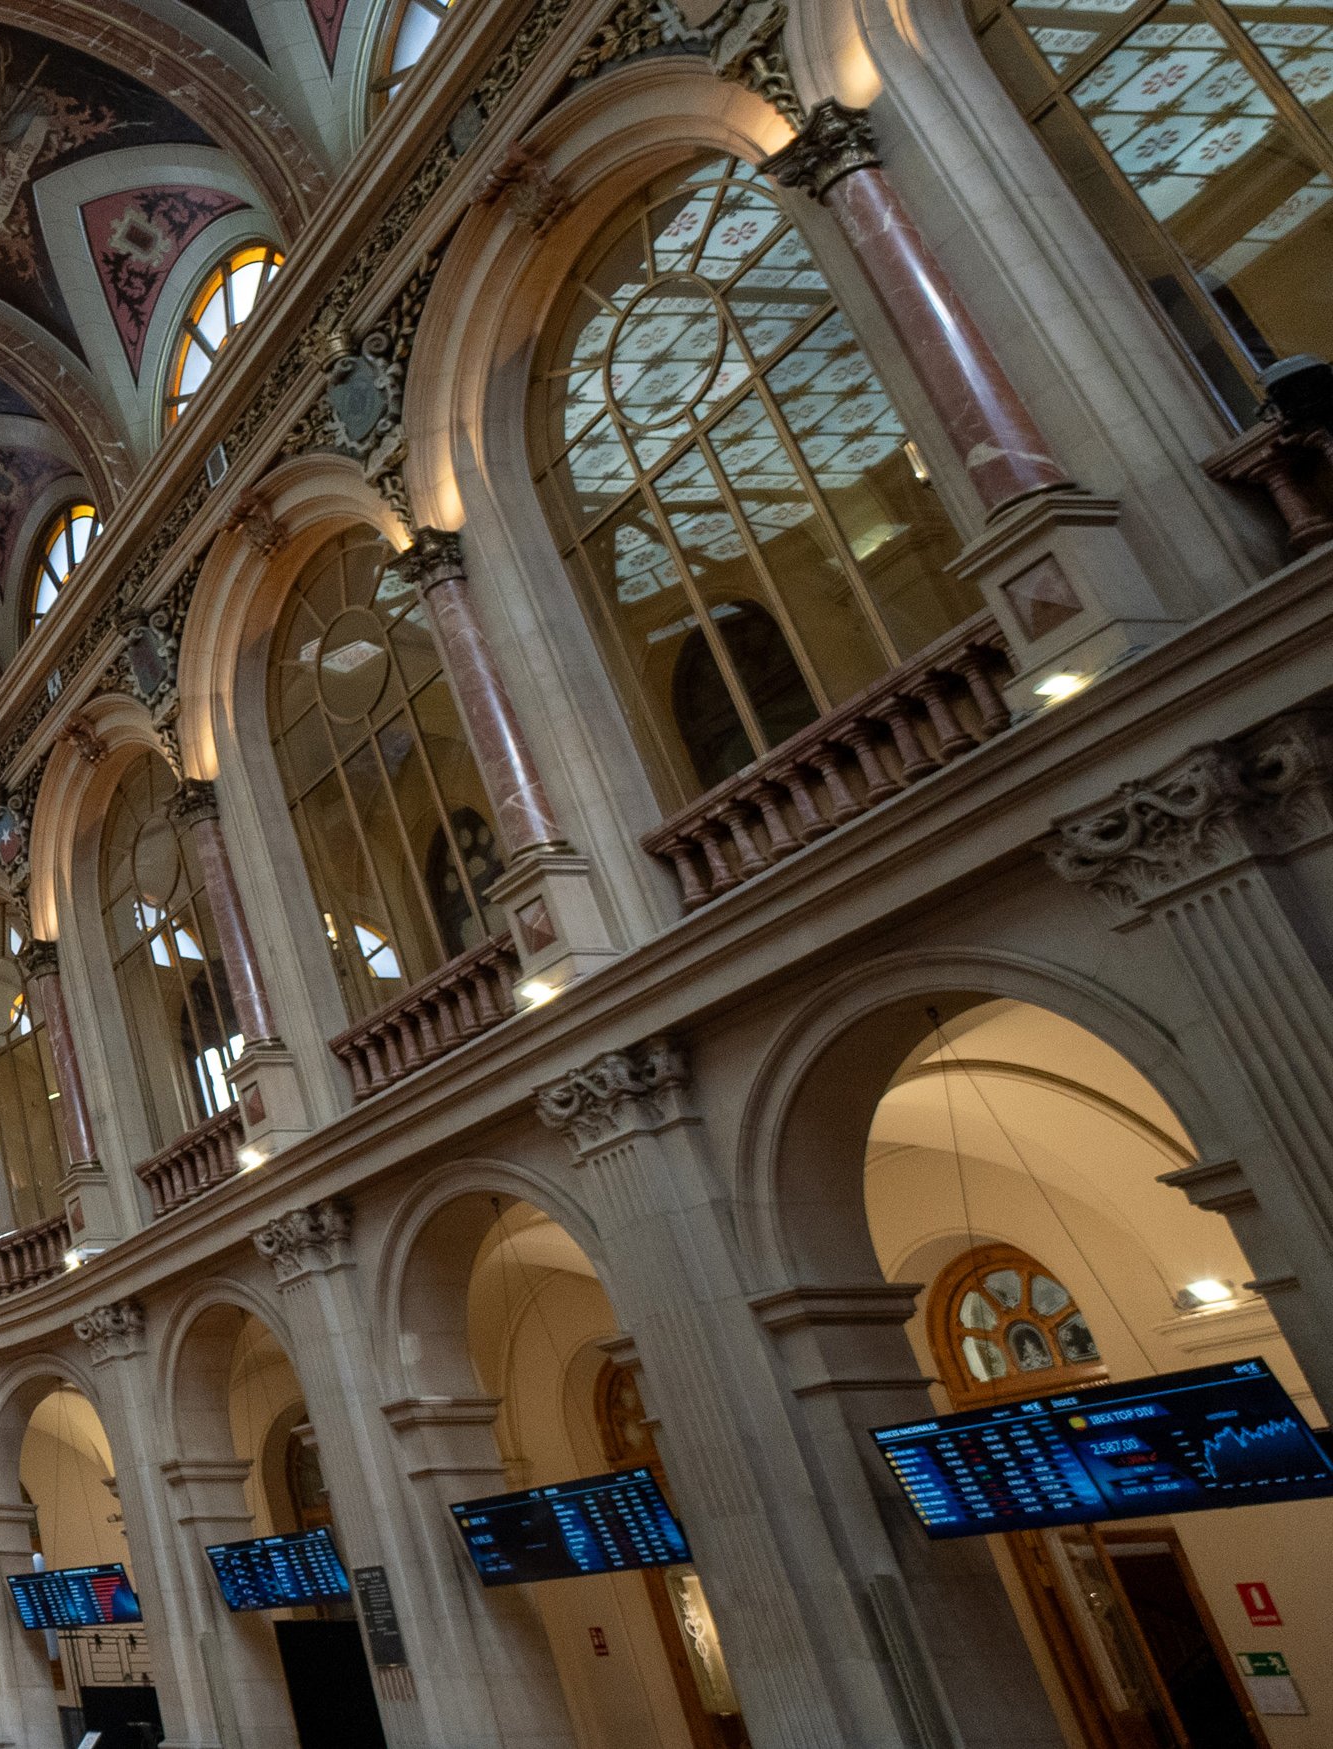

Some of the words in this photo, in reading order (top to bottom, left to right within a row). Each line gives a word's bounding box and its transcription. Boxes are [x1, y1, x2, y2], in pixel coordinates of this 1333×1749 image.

[1089, 1412, 1112, 1426] IBEX
[1112, 1409, 1134, 1423] TOP
[1135, 1406, 1156, 1419] DIV
